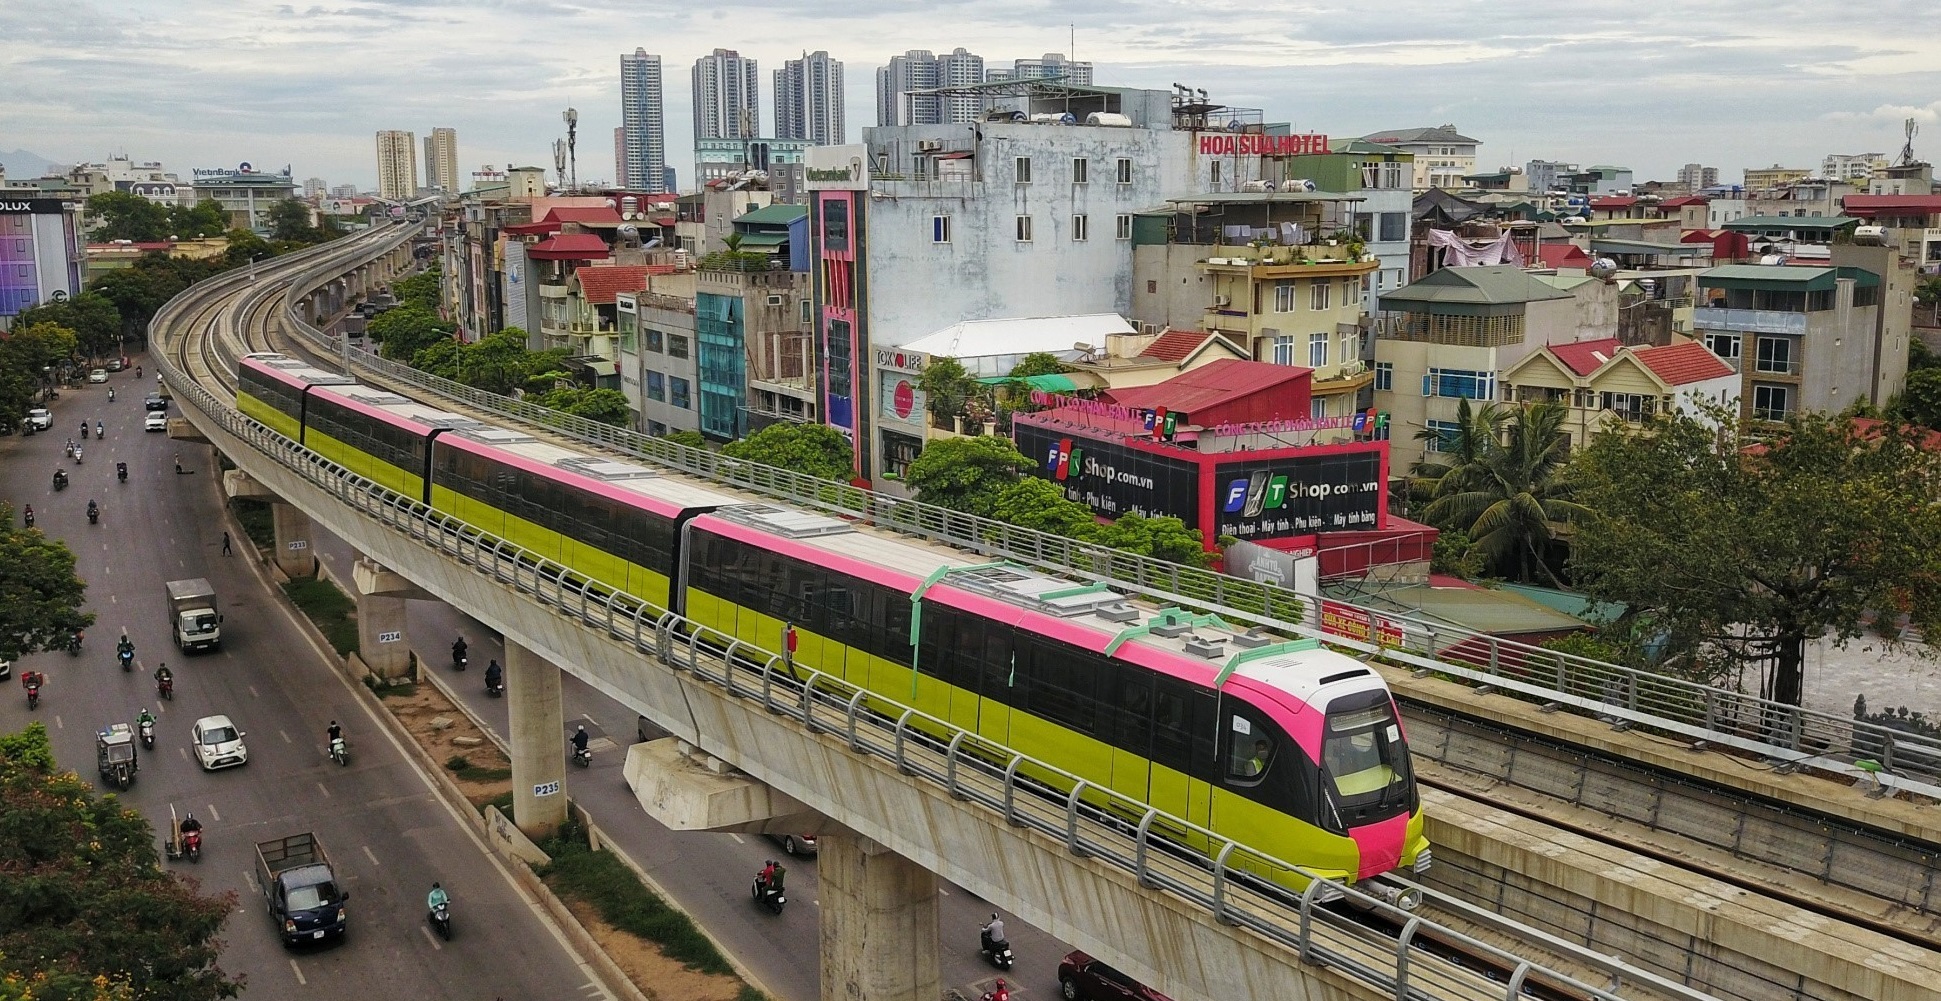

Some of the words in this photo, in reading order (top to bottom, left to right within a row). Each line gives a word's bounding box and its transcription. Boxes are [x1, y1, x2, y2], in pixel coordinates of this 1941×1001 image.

[1200, 135, 1236, 155] HOA
[1278, 134, 1332, 155] HOTEL
[380, 632, 400, 641] P234
[535, 782, 559, 796] P235
